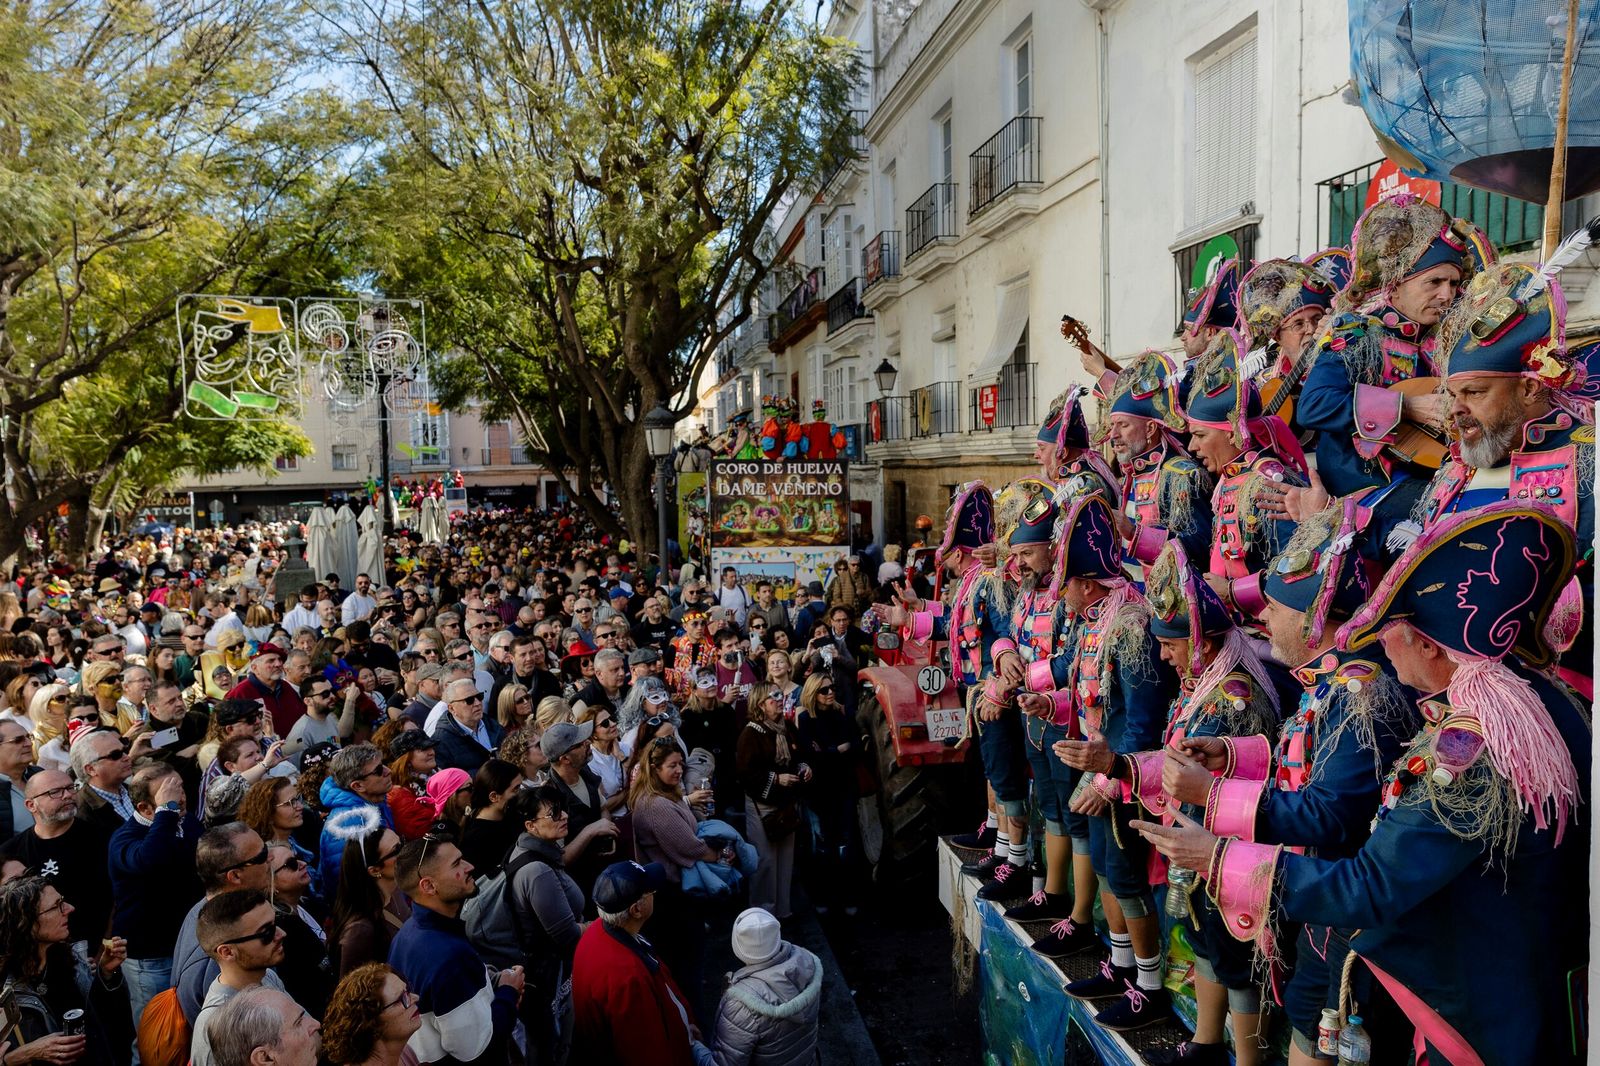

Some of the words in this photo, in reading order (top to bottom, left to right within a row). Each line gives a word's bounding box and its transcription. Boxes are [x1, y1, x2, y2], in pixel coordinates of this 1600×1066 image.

[716, 463, 759, 475] CORO
[763, 463, 783, 475] DE
[787, 463, 843, 475] HUELVA
[718, 482, 767, 496] DAME
[772, 482, 843, 496] VENENO
[922, 669, 941, 691] 30
